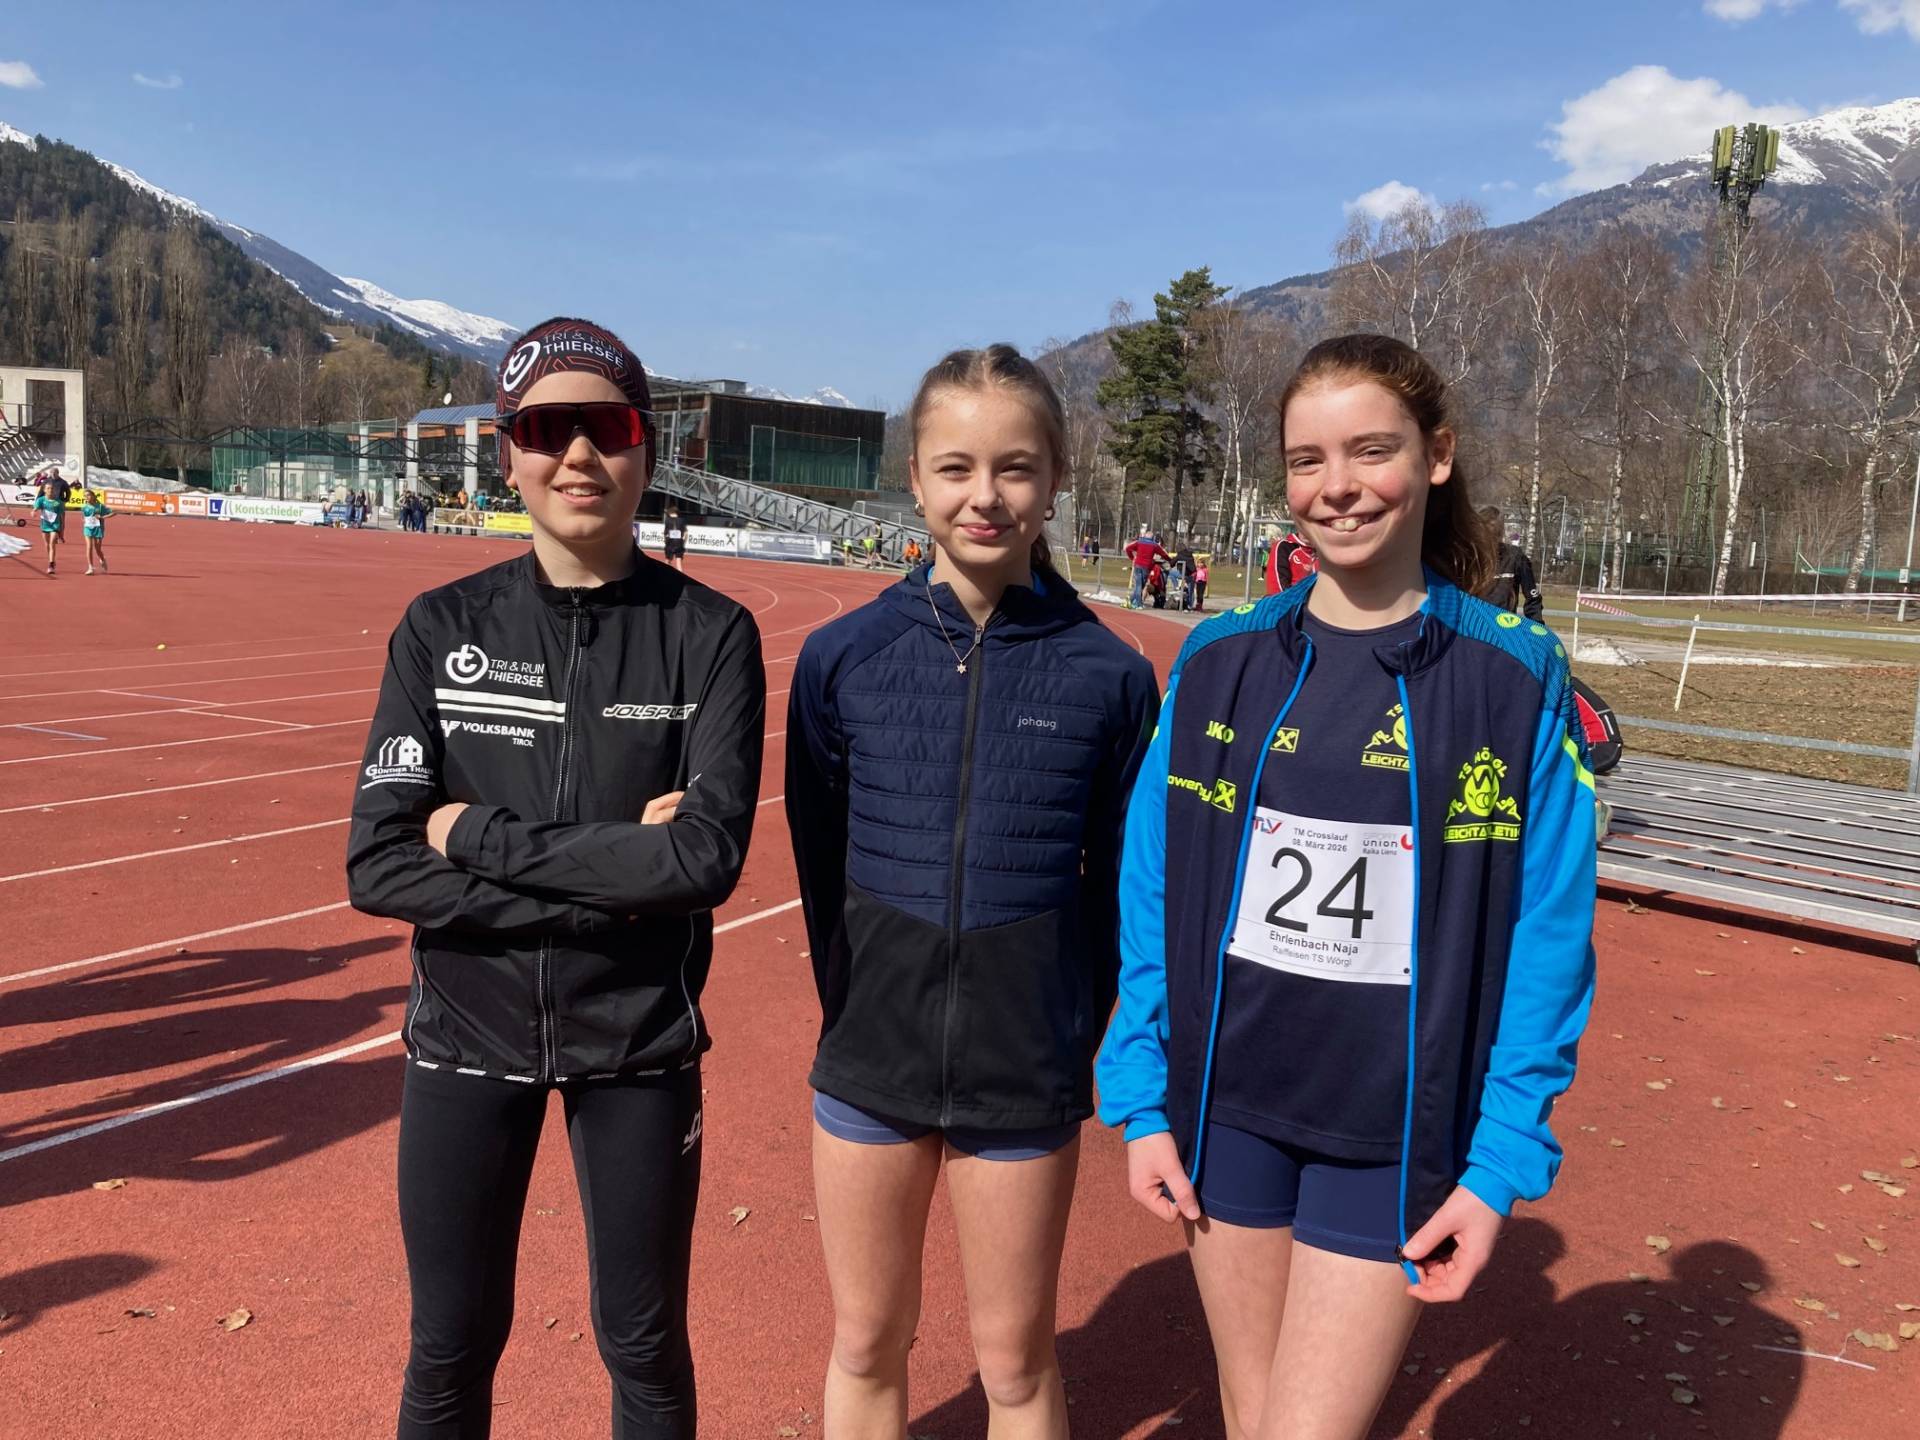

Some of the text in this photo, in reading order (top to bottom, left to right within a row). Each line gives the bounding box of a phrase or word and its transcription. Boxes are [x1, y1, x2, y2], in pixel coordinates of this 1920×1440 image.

[544, 331, 624, 359] TRI & RUN
[543, 340, 625, 370] THIERSEE
[234, 503, 304, 518] Kontschieder
[688, 533, 726, 548] Raiffeisen
[490, 658, 545, 675] TRI & RUN
[488, 669, 544, 688] THIERSEE
[461, 721, 536, 739] VOLKSBANK
[1016, 714, 1057, 731] johaug
[1205, 720, 1235, 744] JKO
[1474, 746, 1508, 779] ÖGL
[1293, 826, 1348, 842] TM Crosslauf
[1305, 840, 1325, 850] März
[1327, 843, 1348, 853] 2026
[1363, 839, 1398, 849] union
[1264, 846, 1374, 940] 24
[1269, 930, 1359, 956] Ehrlenbach Naja
[1272, 945, 1353, 968] Raiffeisen TS Wörgl
